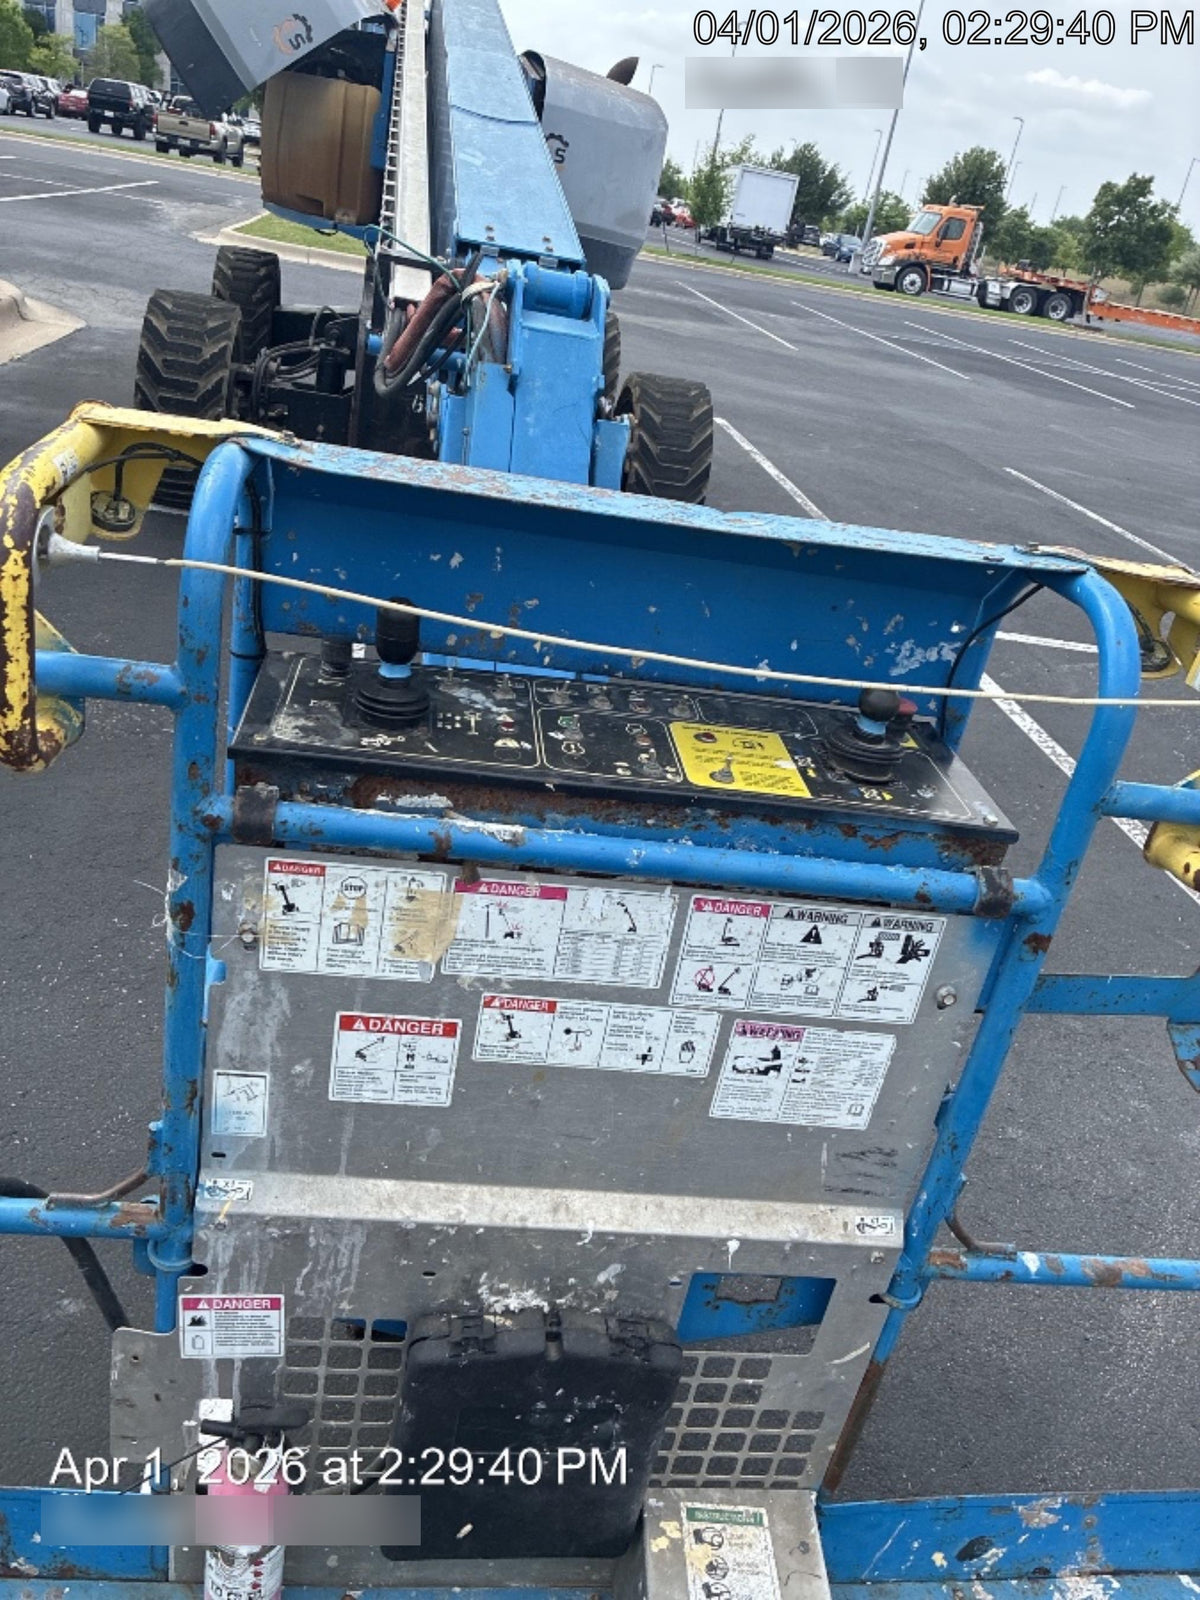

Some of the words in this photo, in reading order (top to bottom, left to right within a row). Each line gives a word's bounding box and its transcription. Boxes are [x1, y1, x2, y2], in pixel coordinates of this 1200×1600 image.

[344, 884, 365, 892] STOP
[490, 884, 541, 897] DANGER
[712, 900, 762, 916] DANGER
[797, 909, 849, 925] WARNING
[883, 918, 934, 933] WARNING
[503, 998, 549, 1011] DANGER
[369, 1018, 444, 1036] DANGER
[212, 1299, 271, 1310] DANGER
